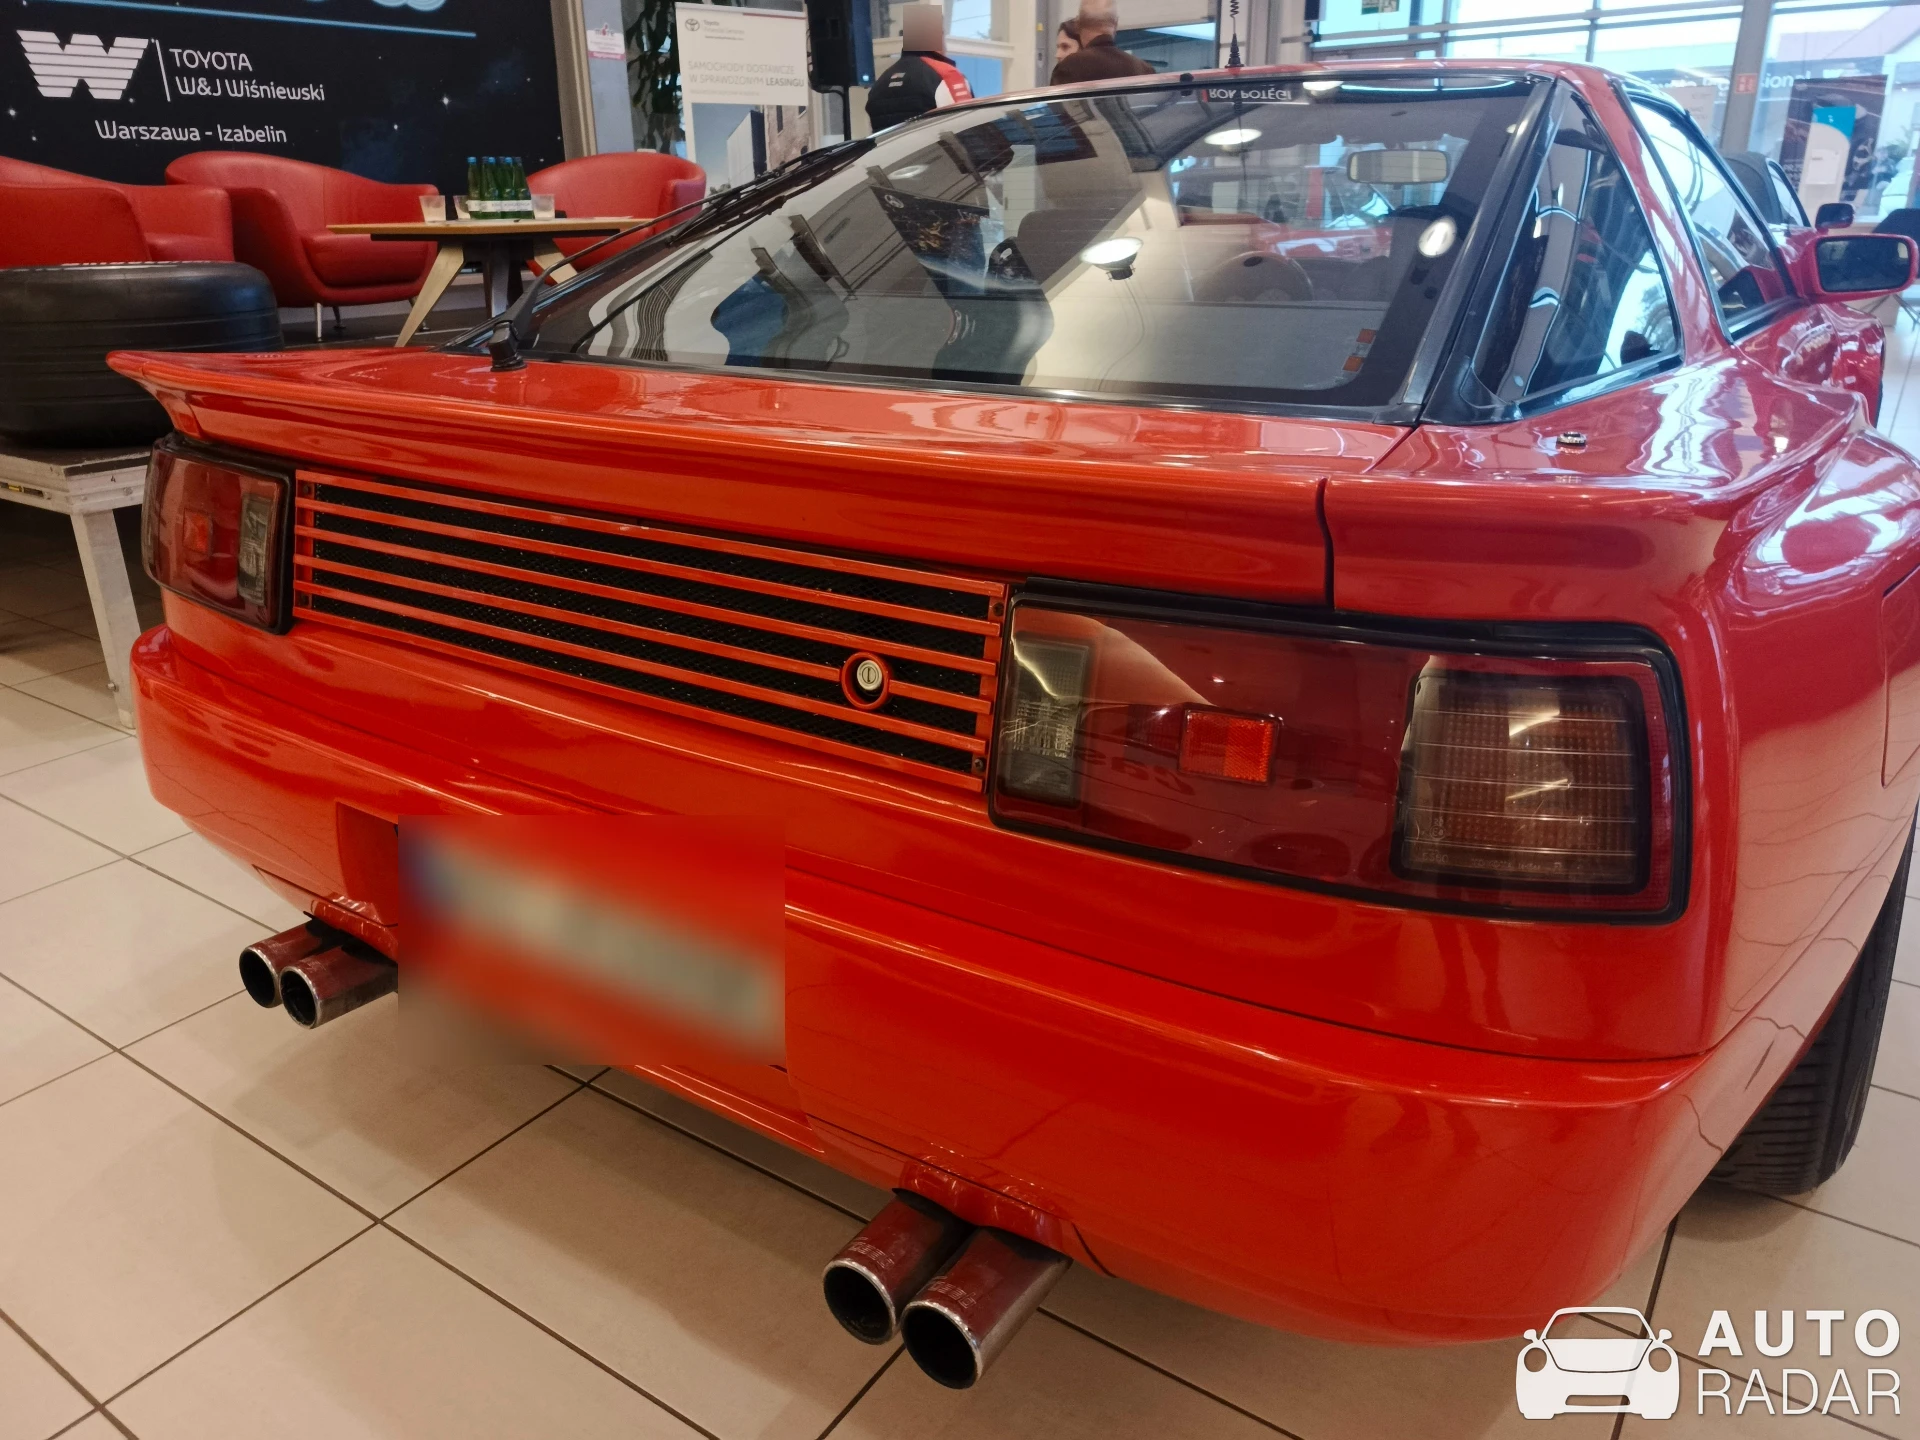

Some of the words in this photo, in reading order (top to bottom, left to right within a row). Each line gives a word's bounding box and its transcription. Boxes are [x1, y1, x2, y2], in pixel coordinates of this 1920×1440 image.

[169, 48, 253, 72] TOYOTA
[688, 61, 745, 73] SAMOCHODY
[747, 63, 796, 75] DOSTAWCZE
[175, 76, 222, 97] W&J
[226, 79, 326, 101] Wiśniewski
[689, 74, 698, 83] W
[699, 75, 764, 86] SPRAWDZONYM
[766, 77, 805, 87] LEASINGU
[95, 120, 201, 142] Warszawa
[218, 124, 288, 143] Izabelin
